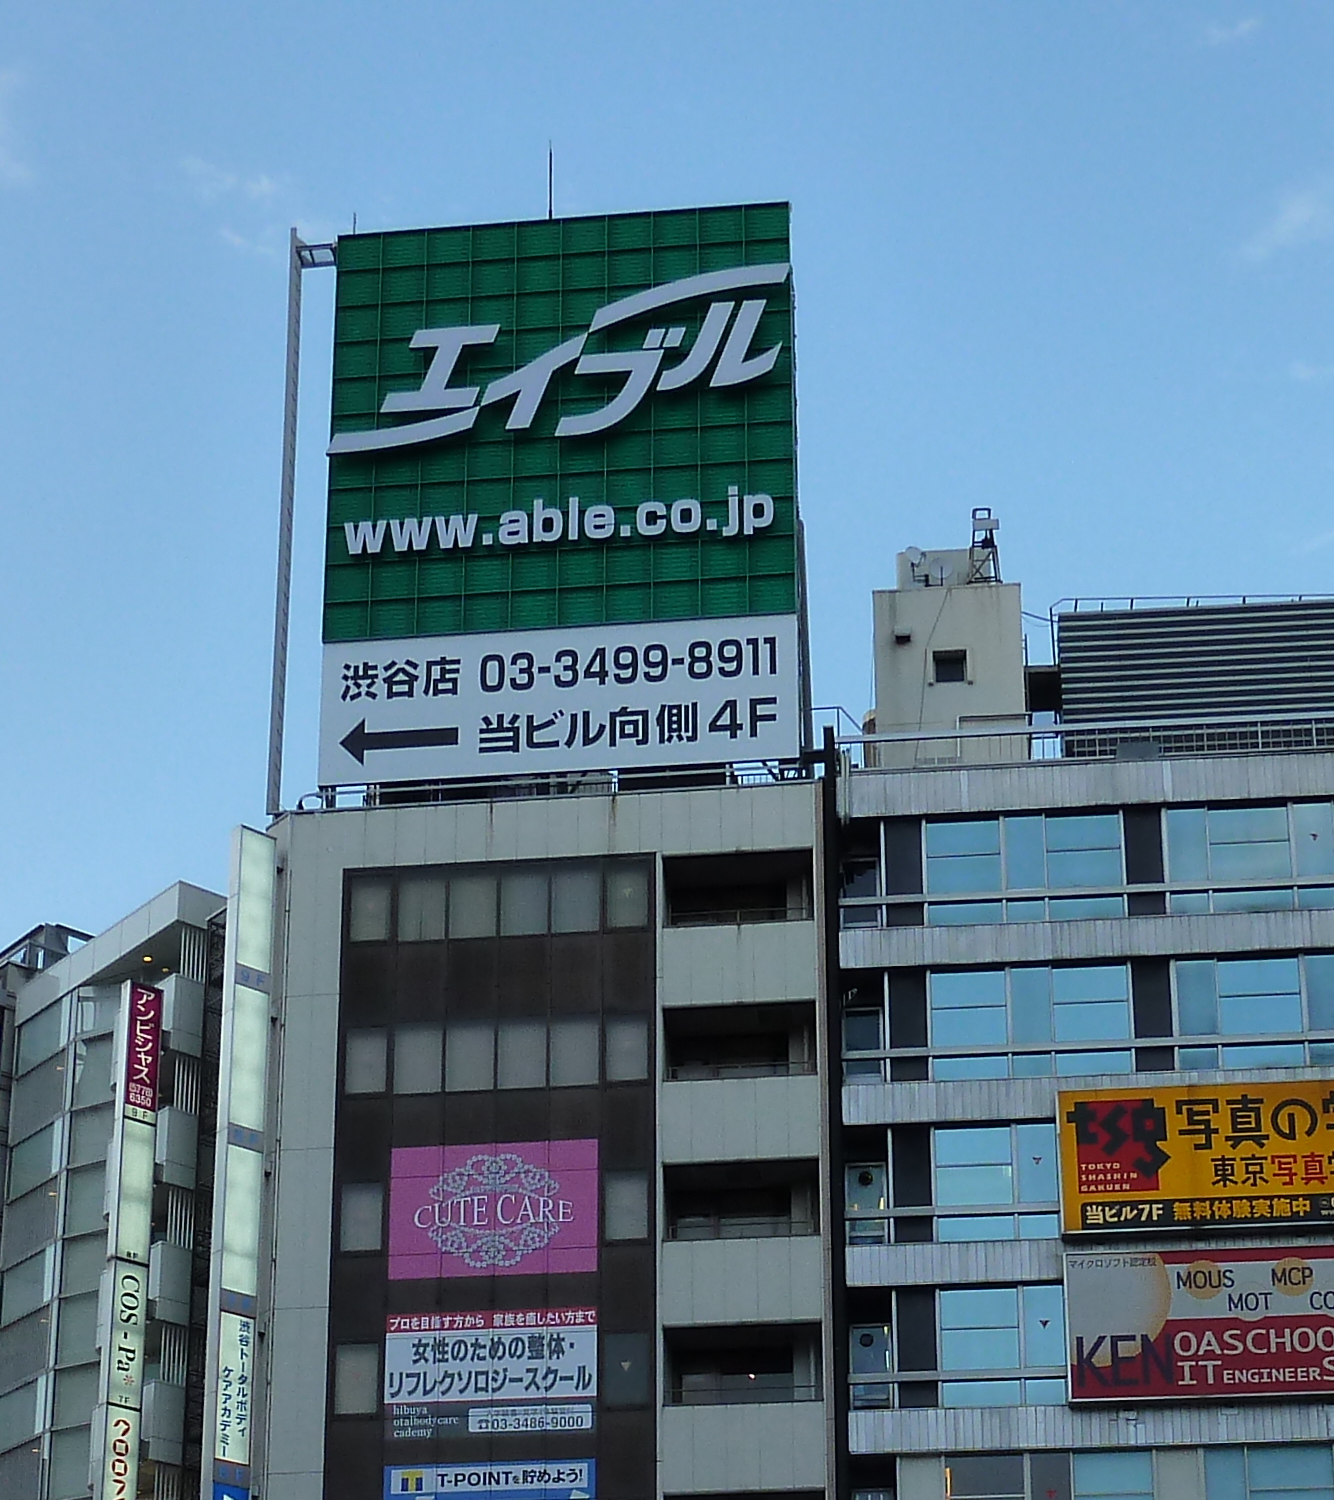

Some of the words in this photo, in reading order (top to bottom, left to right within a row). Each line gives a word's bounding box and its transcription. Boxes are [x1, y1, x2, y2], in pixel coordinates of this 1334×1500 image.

[367, 285, 785, 440] エイブル
[344, 486, 774, 554] www.able.co.jp
[341, 657, 461, 702] 渋谷店
[480, 637, 778, 692] 03-3499-8911
[132, 988, 155, 1084] アンビシャス
[1081, 1163, 1121, 1171] TOKYO
[414, 1196, 488, 1229] CUTE
[497, 1194, 575, 1223] CARE
[1085, 1203, 1164, 1225] 当ビル7F
[1173, 1199, 1311, 1222] 無料体験実施中
[1175, 1269, 1235, 1290] MOUS
[1271, 1266, 1314, 1287] MCP
[1228, 1292, 1273, 1312] MOT
[236, 1319, 251, 1437] 渋谷トータルボディ
[389, 1365, 592, 1400] リフレクソロジースクール
[1075, 1333, 1175, 1389] KEN
[1177, 1359, 1222, 1385] IT
[1223, 1367, 1321, 1384] ENGINEER
[220, 1366, 233, 1457] ケアアカデミー
